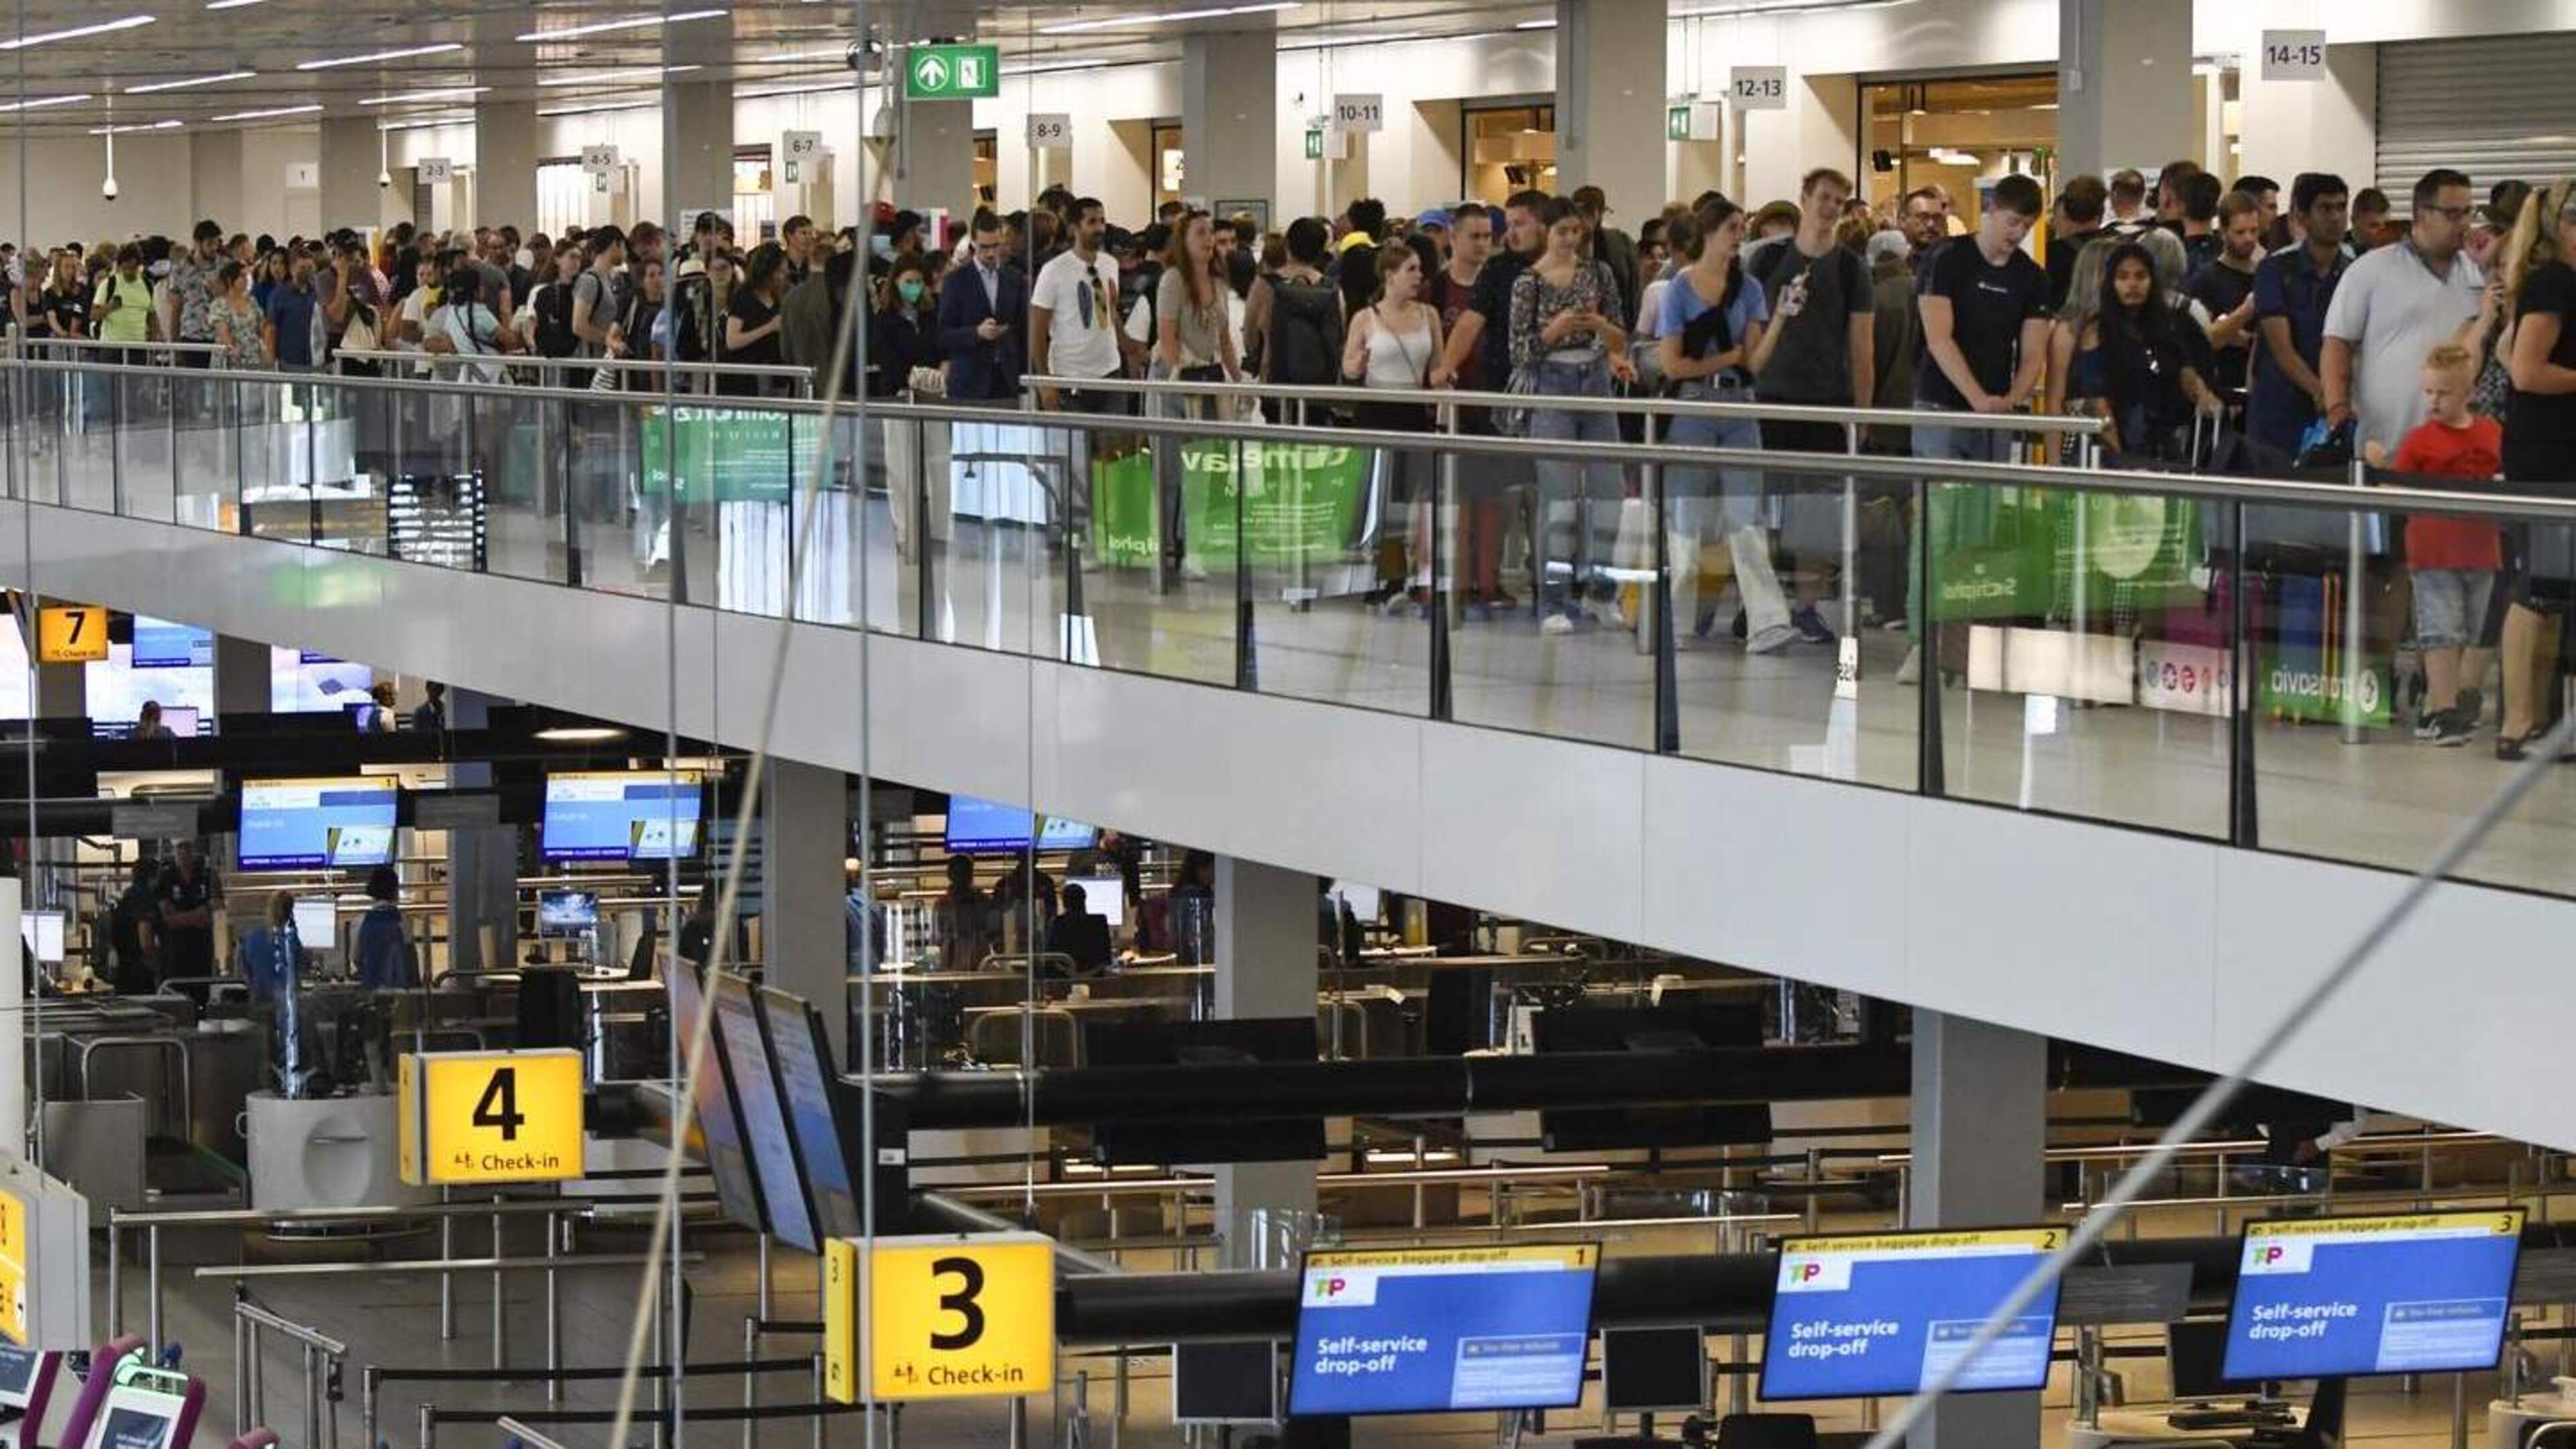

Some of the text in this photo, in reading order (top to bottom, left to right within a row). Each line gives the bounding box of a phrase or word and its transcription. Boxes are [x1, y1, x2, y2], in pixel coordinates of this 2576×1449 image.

[2268, 45, 2321, 65] 14-15
[1735, 79, 1782, 97] 12-13
[1339, 105, 1379, 121] 10-11
[1037, 124, 1061, 138] 8-9
[792, 140, 814, 153] 6-7
[65, 610, 86, 645] 7
[472, 1067, 525, 1140] 4
[482, 1151, 559, 1171] Check-in
[2498, 1215, 2514, 1232] 3
[2042, 1230, 2057, 1250] 2
[1575, 1247, 1585, 1266] 1
[930, 1256, 985, 1351] 3
[2251, 1301, 2359, 1322] Self-service
[1790, 1319, 1900, 1340] Self-service
[2248, 1320, 2328, 1341] drop-off
[1318, 1335, 1428, 1355] Self-service
[1788, 1338, 1868, 1360] drop-off
[928, 1364, 1024, 1387] Check-in
[1315, 1354, 1397, 1377] drop-off
